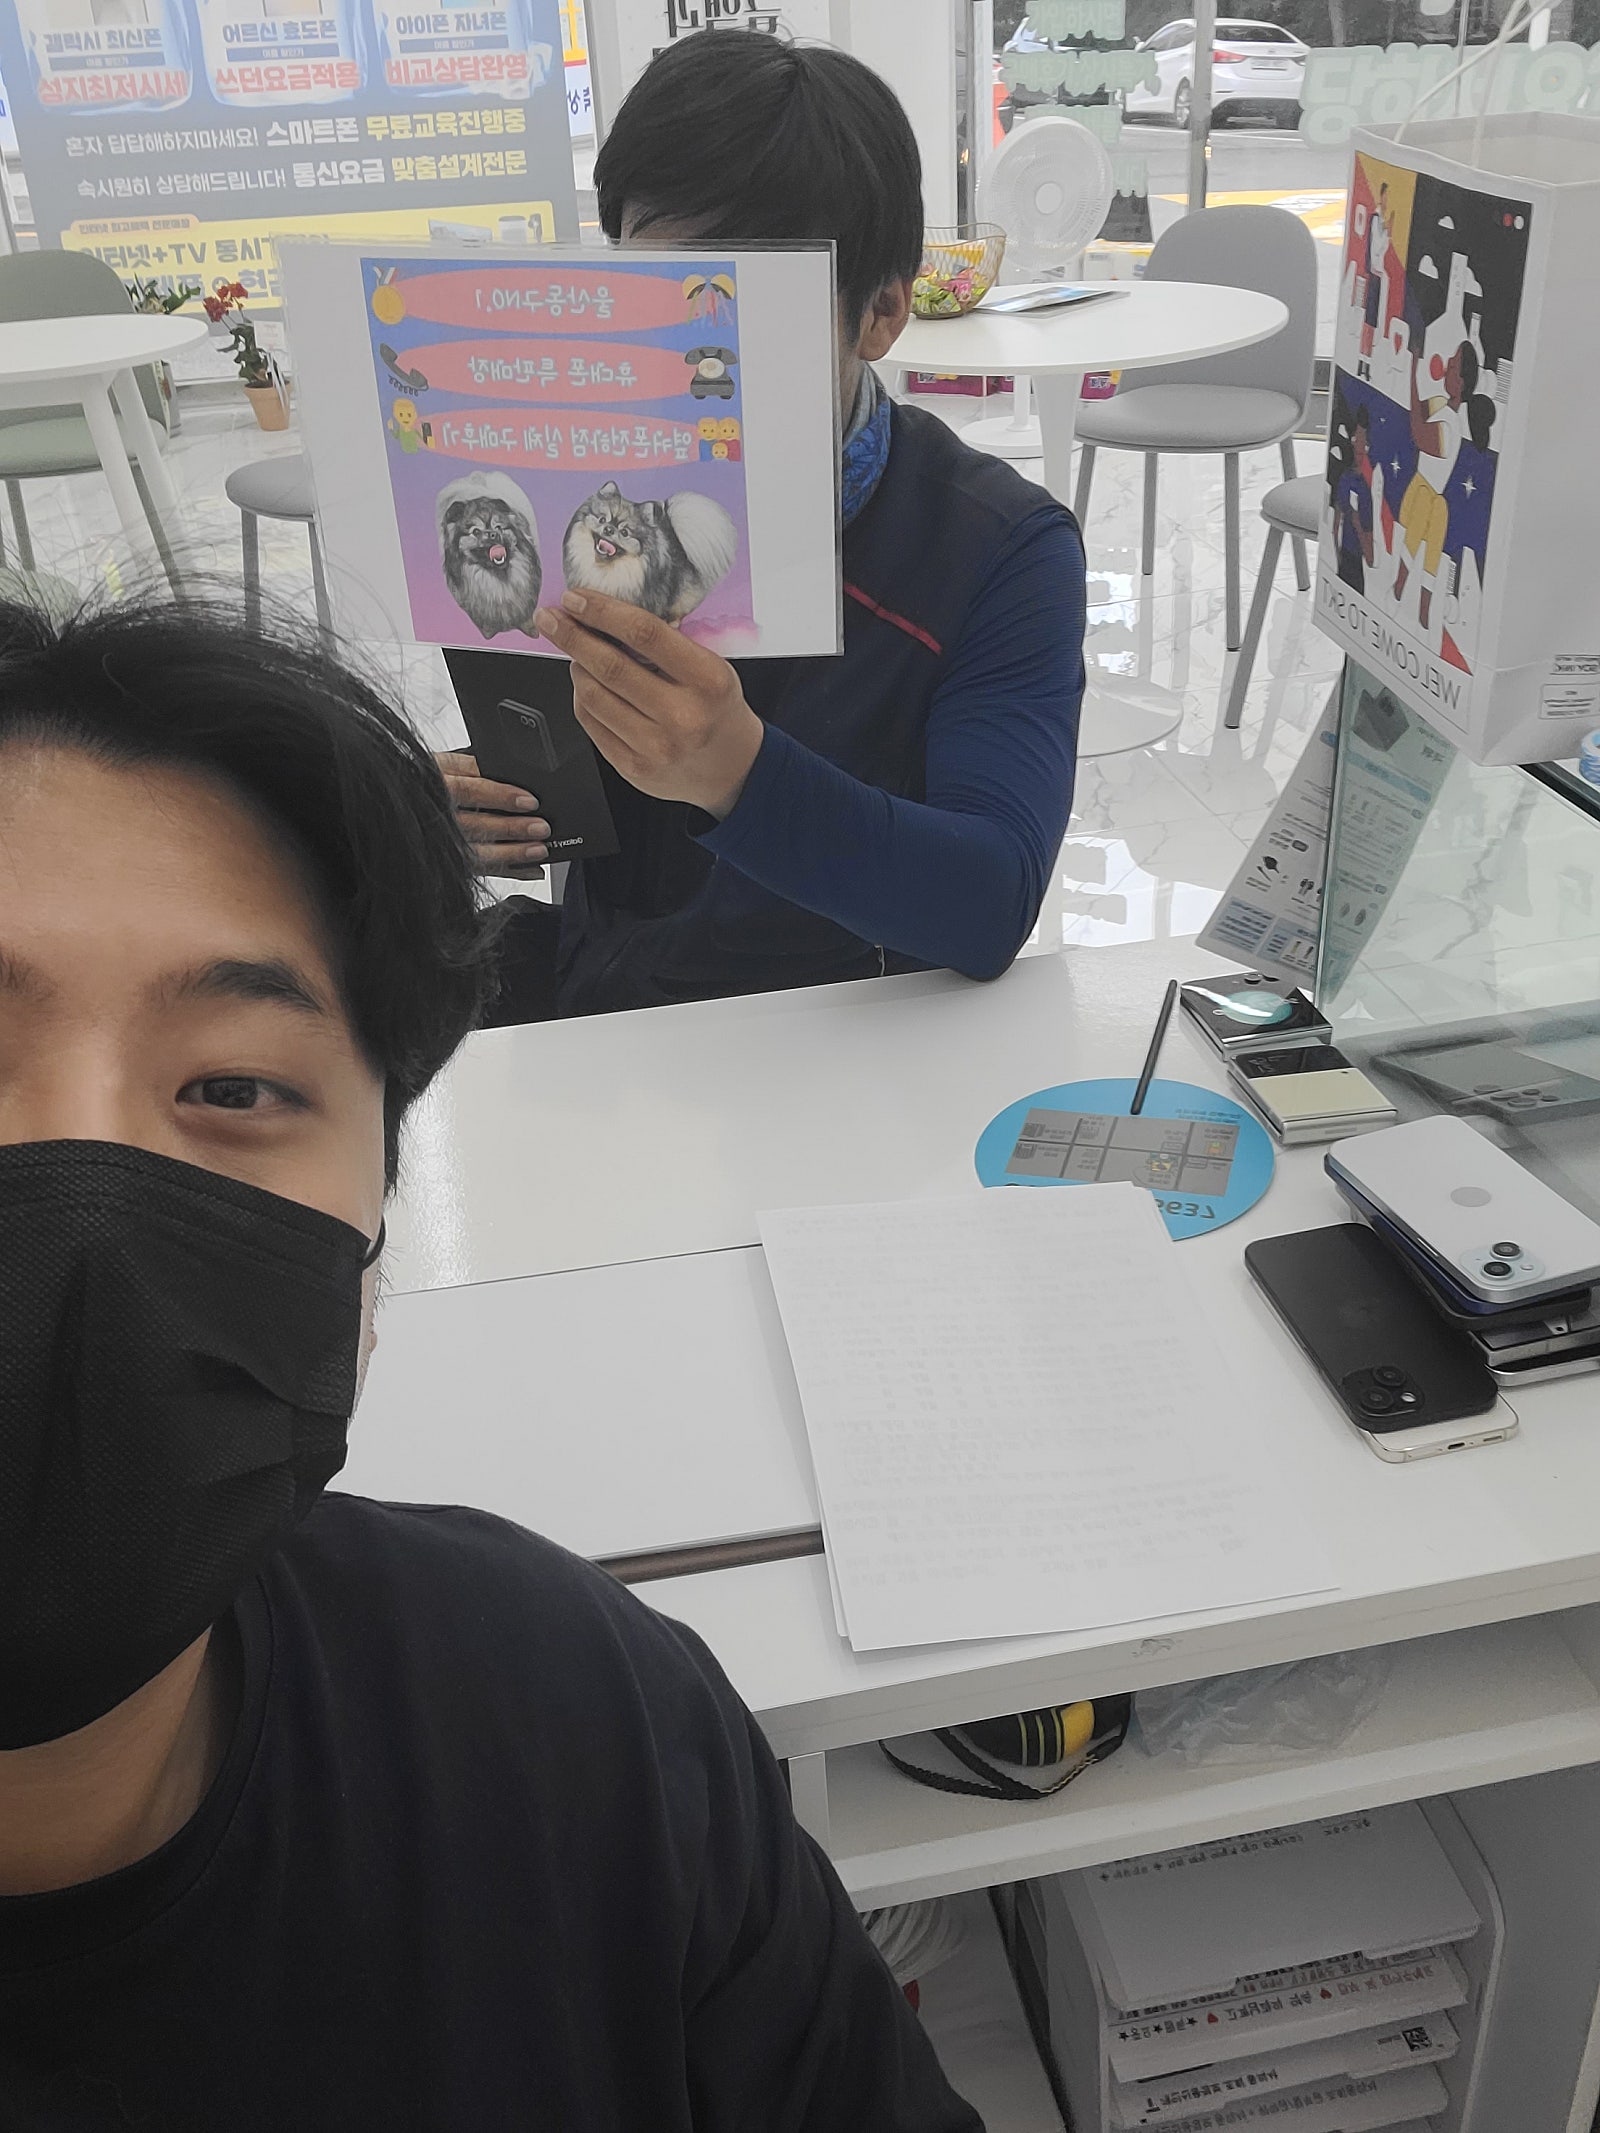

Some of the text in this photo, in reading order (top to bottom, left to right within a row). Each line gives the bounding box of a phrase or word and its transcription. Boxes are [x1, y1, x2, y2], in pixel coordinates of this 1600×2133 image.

[222, 19, 338, 43] 어르신 효도폰
[396, 11, 508, 35] 아이폰 자녀폰
[43, 27, 163, 53] 갤럭시 최신폰
[215, 61, 360, 95] 쓰던요금적용
[385, 53, 529, 85] 비교상담환영
[39, 70, 189, 104] 성지최저시세
[65, 108, 527, 157] 혼자 답답해하지마세요! 스마트폰 무료교육진행중
[77, 152, 528, 198] 속시원히 상담해드립니다! 통신요금 맞춤설계전문
